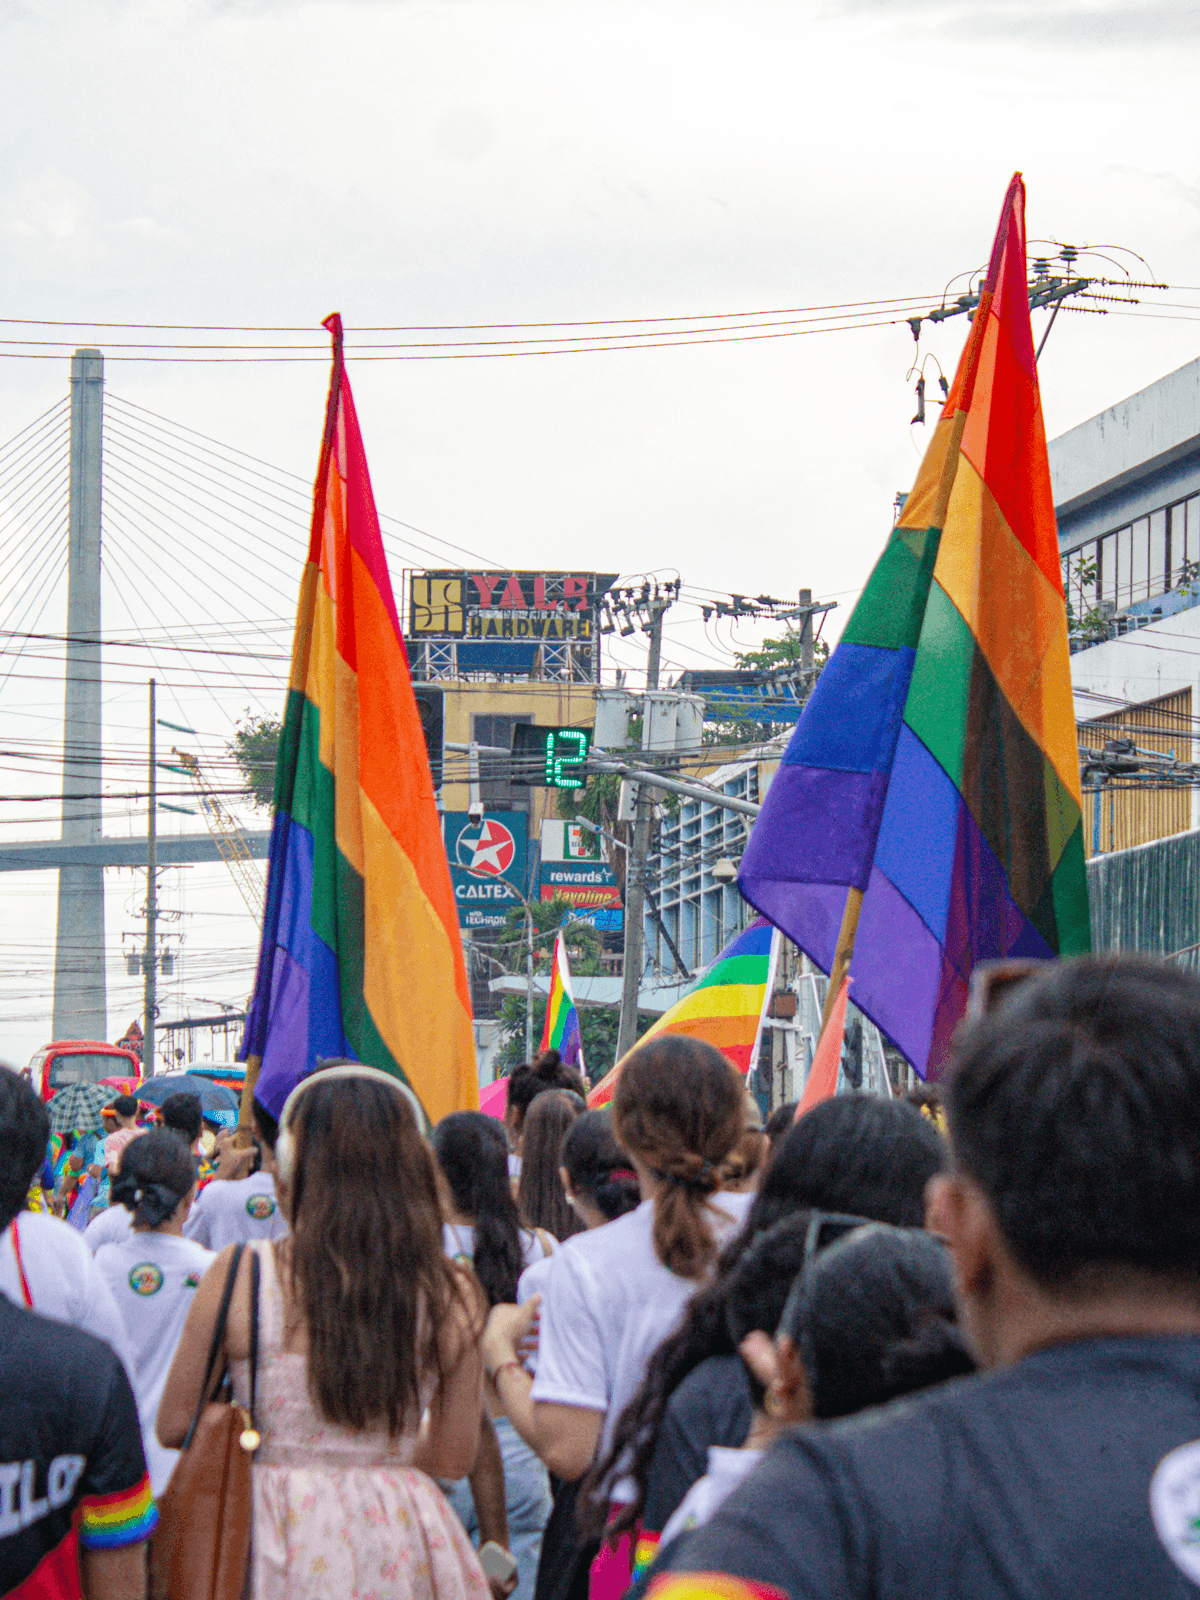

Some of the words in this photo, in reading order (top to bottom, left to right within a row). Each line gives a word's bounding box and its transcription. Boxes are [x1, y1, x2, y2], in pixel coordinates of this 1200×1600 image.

[470, 618, 588, 637] HARDWARE
[545, 731, 586, 787] 12
[550, 871, 602, 883] rewards
[455, 884, 515, 898] CALTEX
